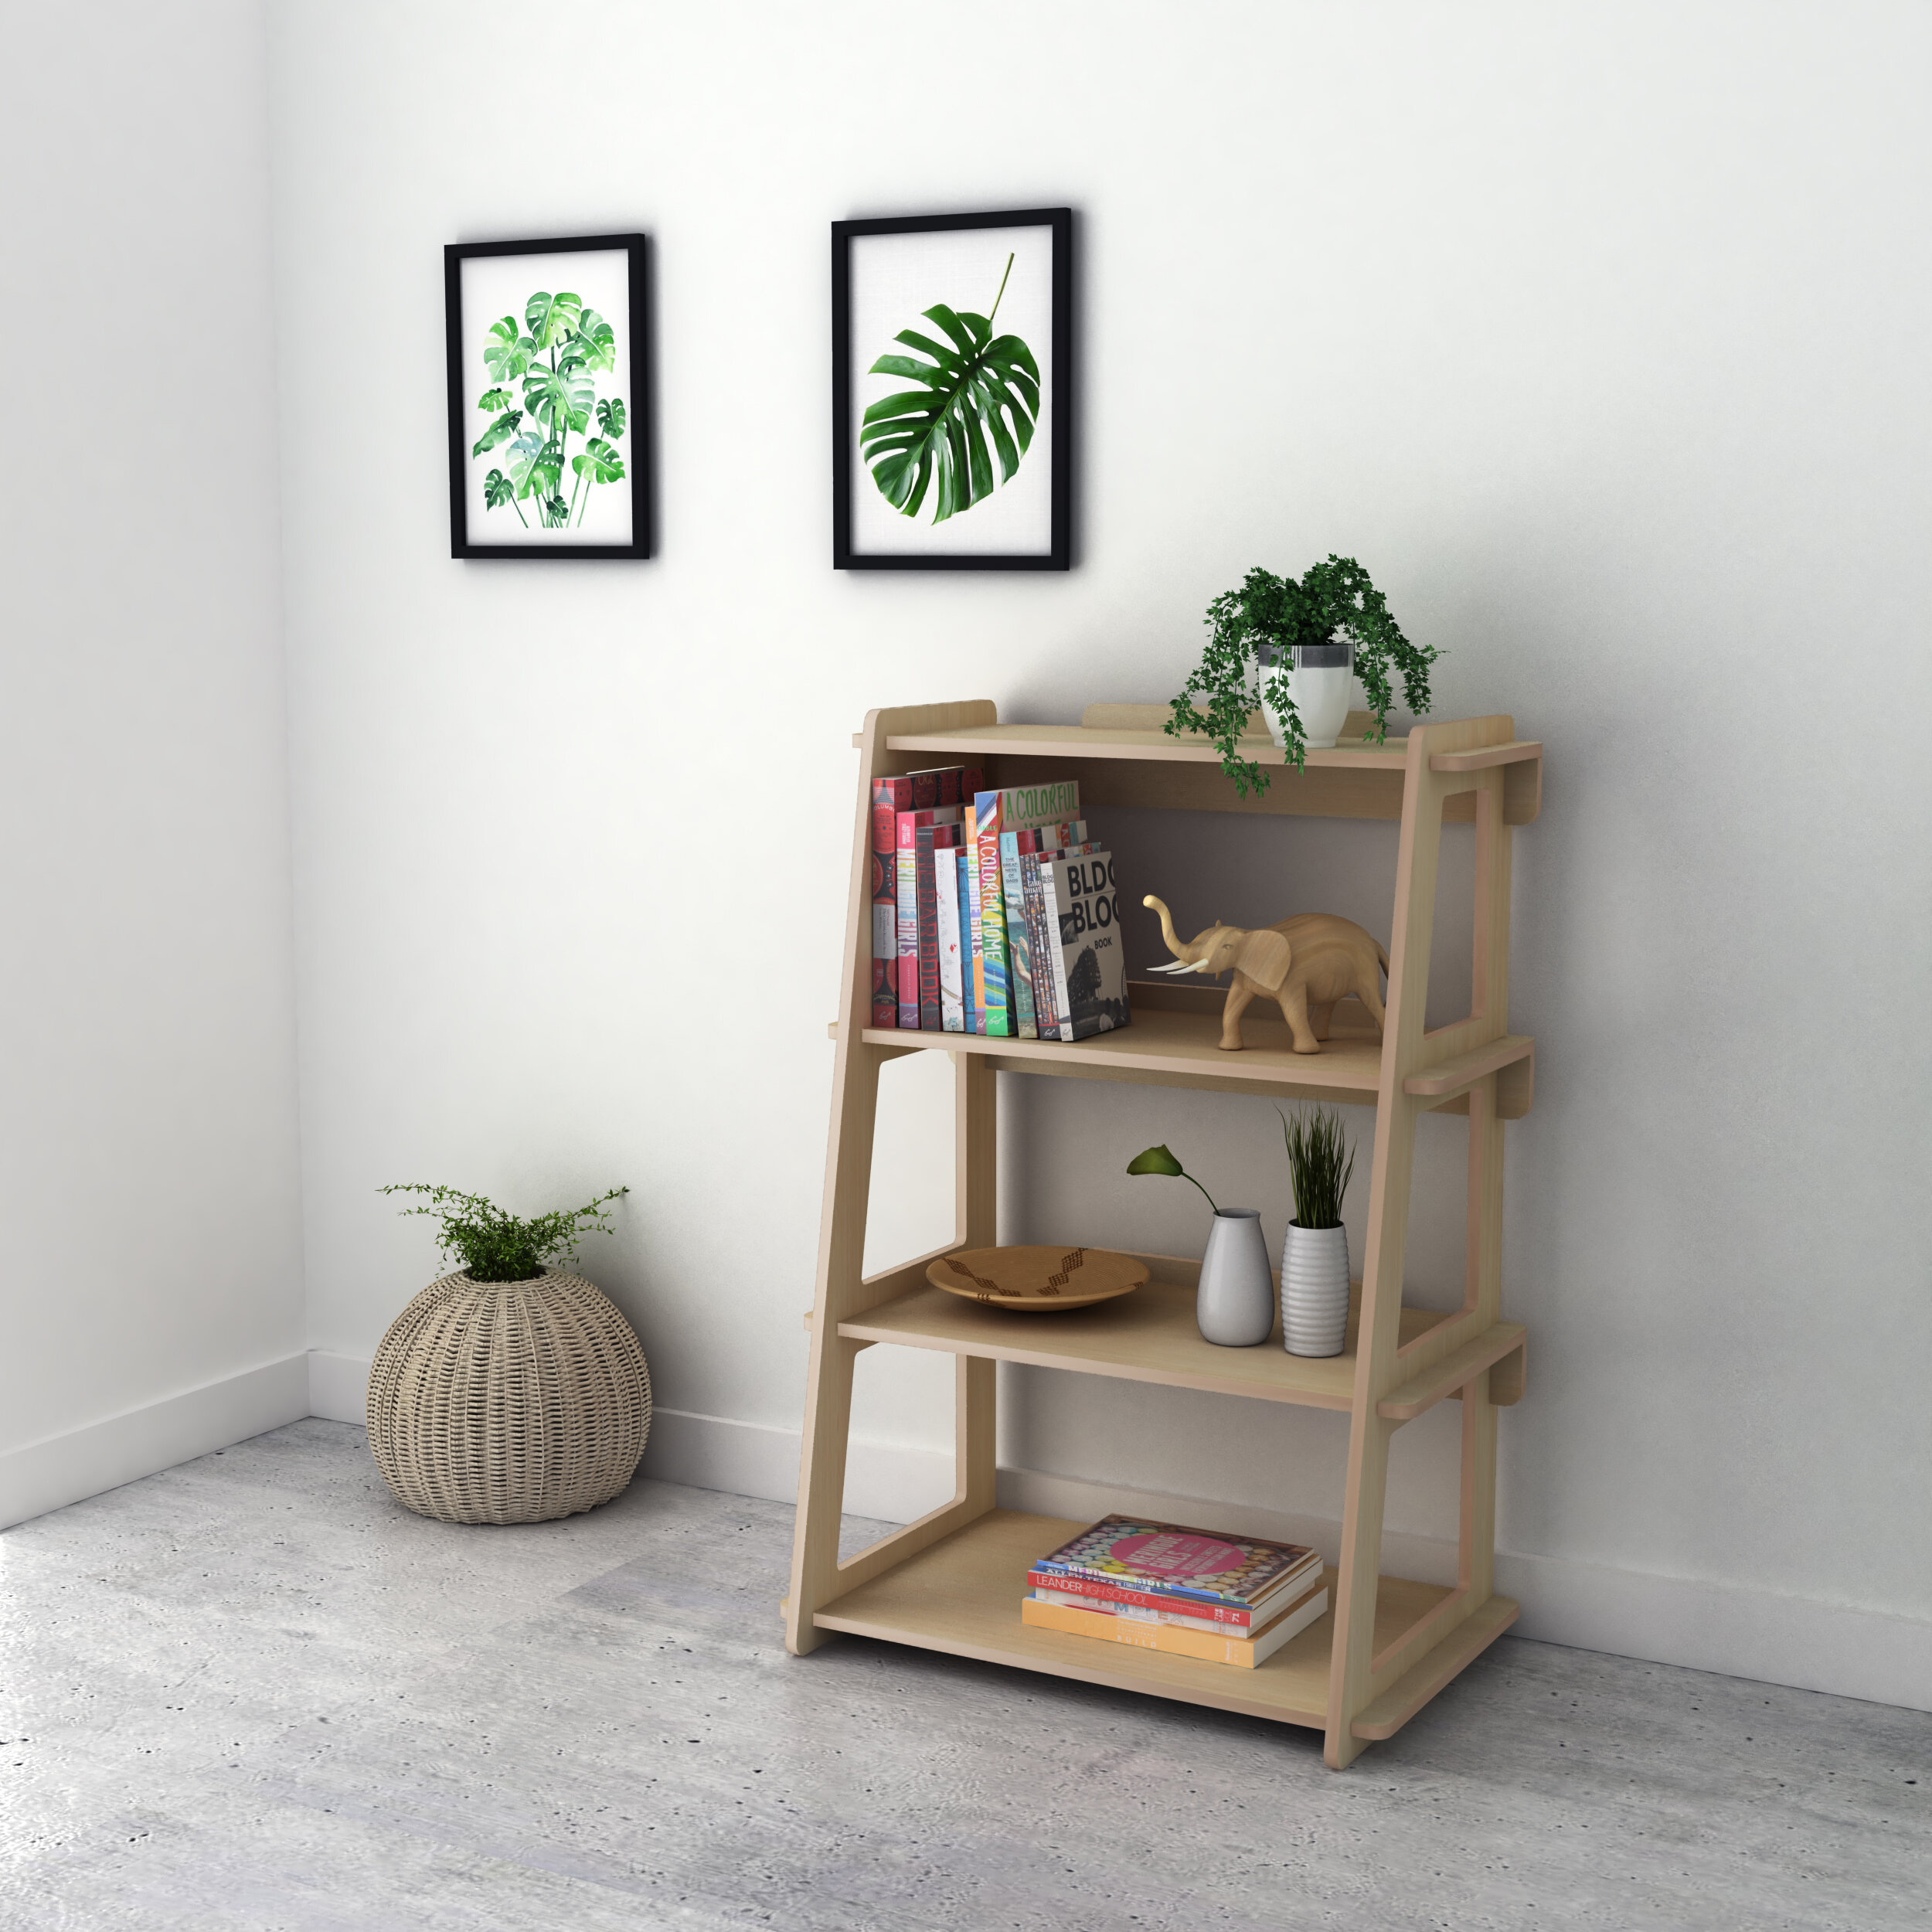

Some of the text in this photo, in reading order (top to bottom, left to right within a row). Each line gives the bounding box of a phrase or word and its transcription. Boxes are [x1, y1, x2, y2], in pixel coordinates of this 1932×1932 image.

[1006, 783, 1078, 821] A COLORFUL
[896, 849, 917, 918] MERINGUE
[967, 844, 981, 917] MERINGUE
[979, 835, 1002, 960] A COLORFUL HOME
[1027, 878, 1042, 887] take
[918, 888, 937, 937] BAR
[897, 919, 917, 957] GIRLS
[971, 917, 983, 958] GIRLS
[1094, 937, 1113, 950] BOOK
[920, 942, 939, 1008] BOOK
[1122, 1535, 1184, 1564] MERINGUE
[1148, 1550, 1192, 1570] GIRLS
[1037, 1575, 1082, 1593] LEANDER
[1082, 1583, 1105, 1597] HIGH
[1106, 1588, 1148, 1605] SCHOOL
[1232, 1613, 1240, 1623] 71
[1117, 1634, 1157, 1648] BUILD
